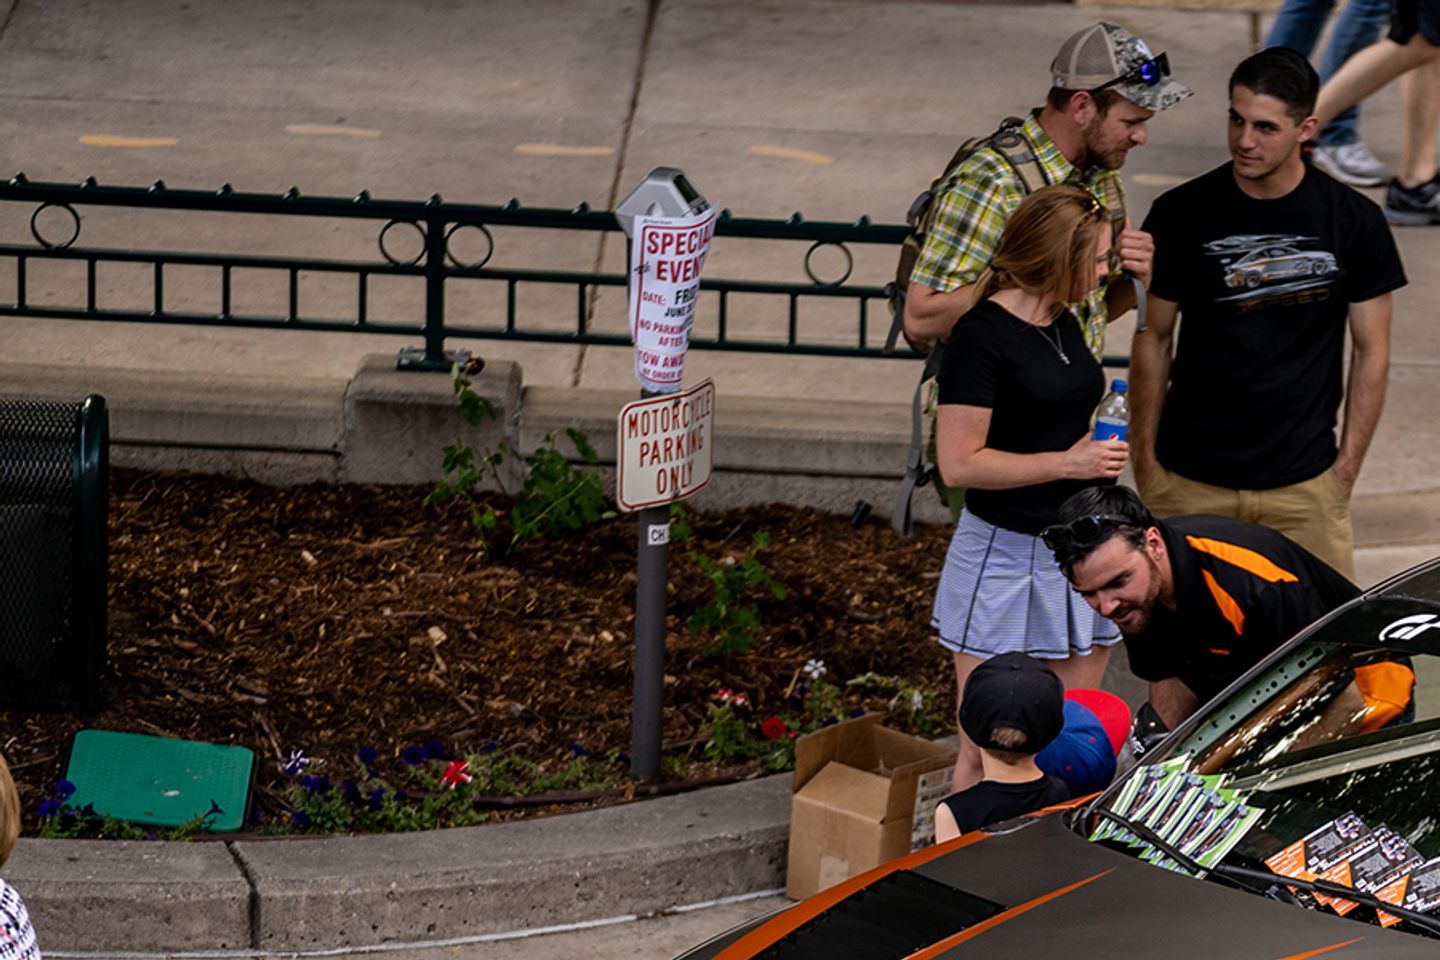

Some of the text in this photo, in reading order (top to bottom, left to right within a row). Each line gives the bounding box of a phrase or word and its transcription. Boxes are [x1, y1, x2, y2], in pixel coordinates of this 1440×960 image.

[628, 390, 712, 439] MOTORCYCLE
[640, 424, 704, 468] PARKING
[656, 459, 694, 495] ONLY
